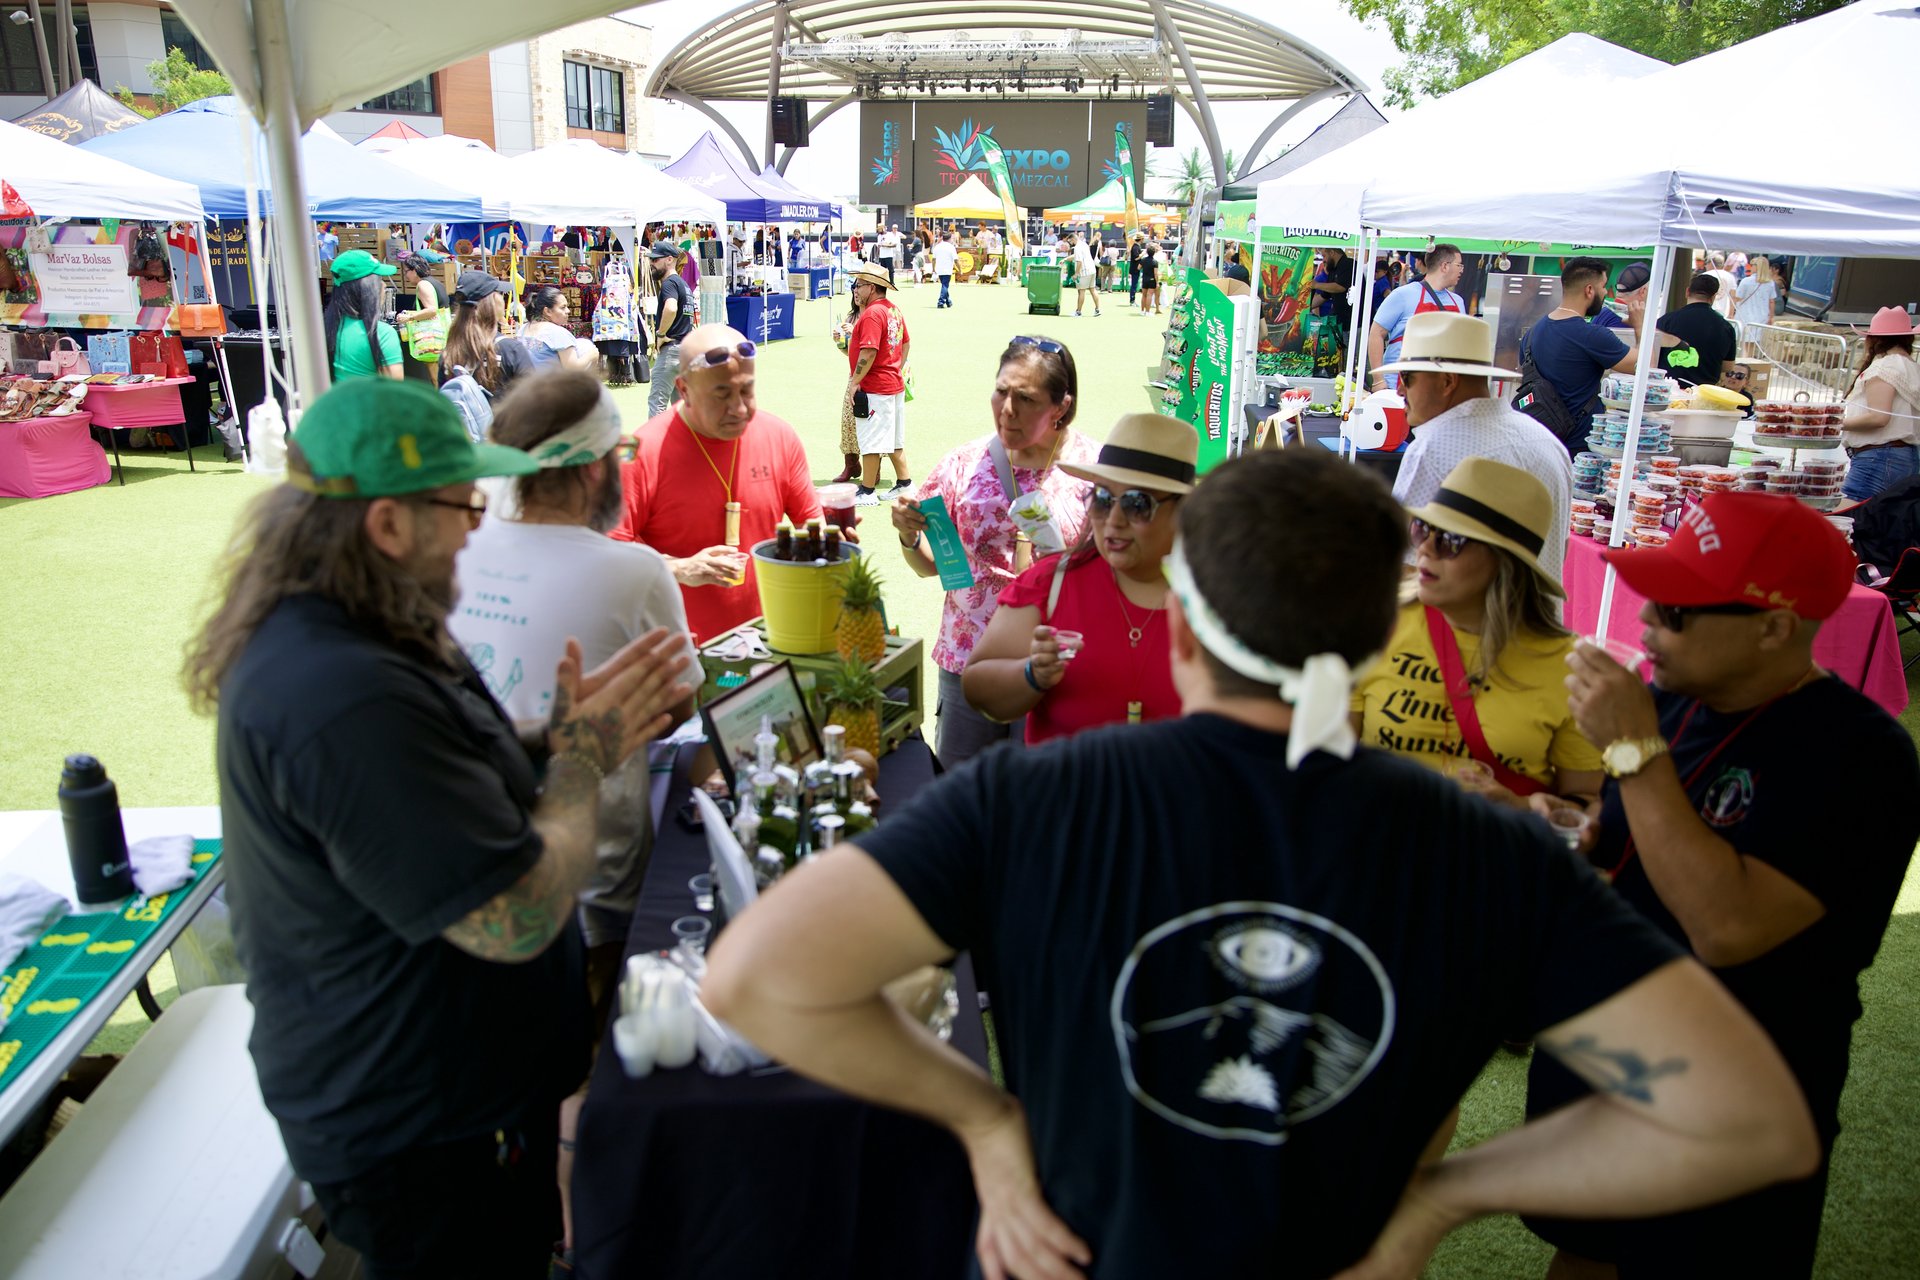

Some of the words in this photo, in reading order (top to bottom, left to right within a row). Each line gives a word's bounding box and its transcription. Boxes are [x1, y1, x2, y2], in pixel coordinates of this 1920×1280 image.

[883, 121, 893, 157] EXPO
[1012, 172, 1072, 188] MEZCAL
[780, 204, 819, 218] JIMADLER.COM
[47, 254, 81, 264] MarVaz
[82, 253, 112, 265] Bolsas
[1261, 244, 1301, 261] AQUERITOS
[1206, 319, 1216, 336] UP
[1213, 316, 1229, 362] MOMENT
[1206, 333, 1220, 367] LIGHT
[1208, 381, 1225, 440] TAQUERITOS
